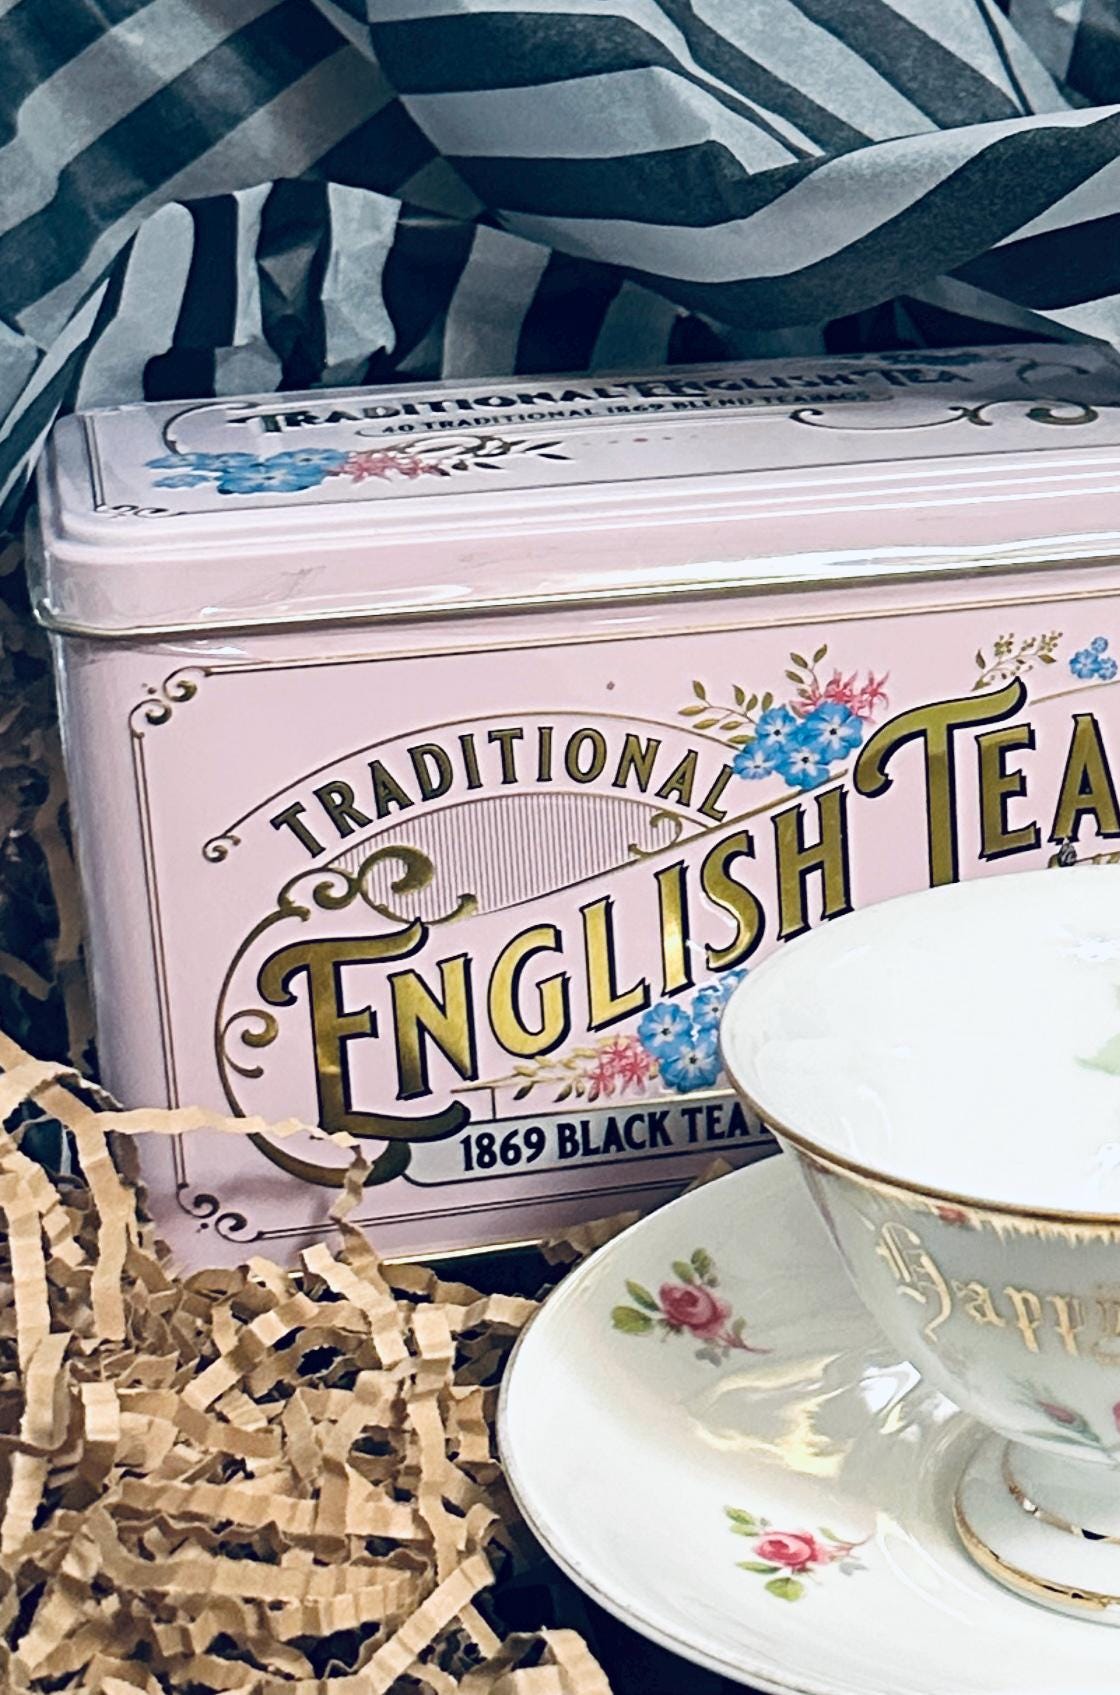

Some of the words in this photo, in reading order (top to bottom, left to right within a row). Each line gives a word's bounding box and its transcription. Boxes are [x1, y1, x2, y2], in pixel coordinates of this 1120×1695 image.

[227, 387, 628, 432] TRADITIONAL
[612, 374, 857, 397] ENGLISH
[850, 368, 974, 387] TEA
[382, 424, 415, 433] 40
[423, 409, 593, 430] TRADITIONAL
[607, 403, 664, 414] 1869
[672, 397, 754, 411] BLEND
[272, 725, 736, 860] TRADITIONAL
[257, 783, 854, 1143] ENGLISH
[460, 1126, 546, 1172] 1869
[557, 1110, 673, 1160] BLACK
[681, 1101, 751, 1143] TEA
